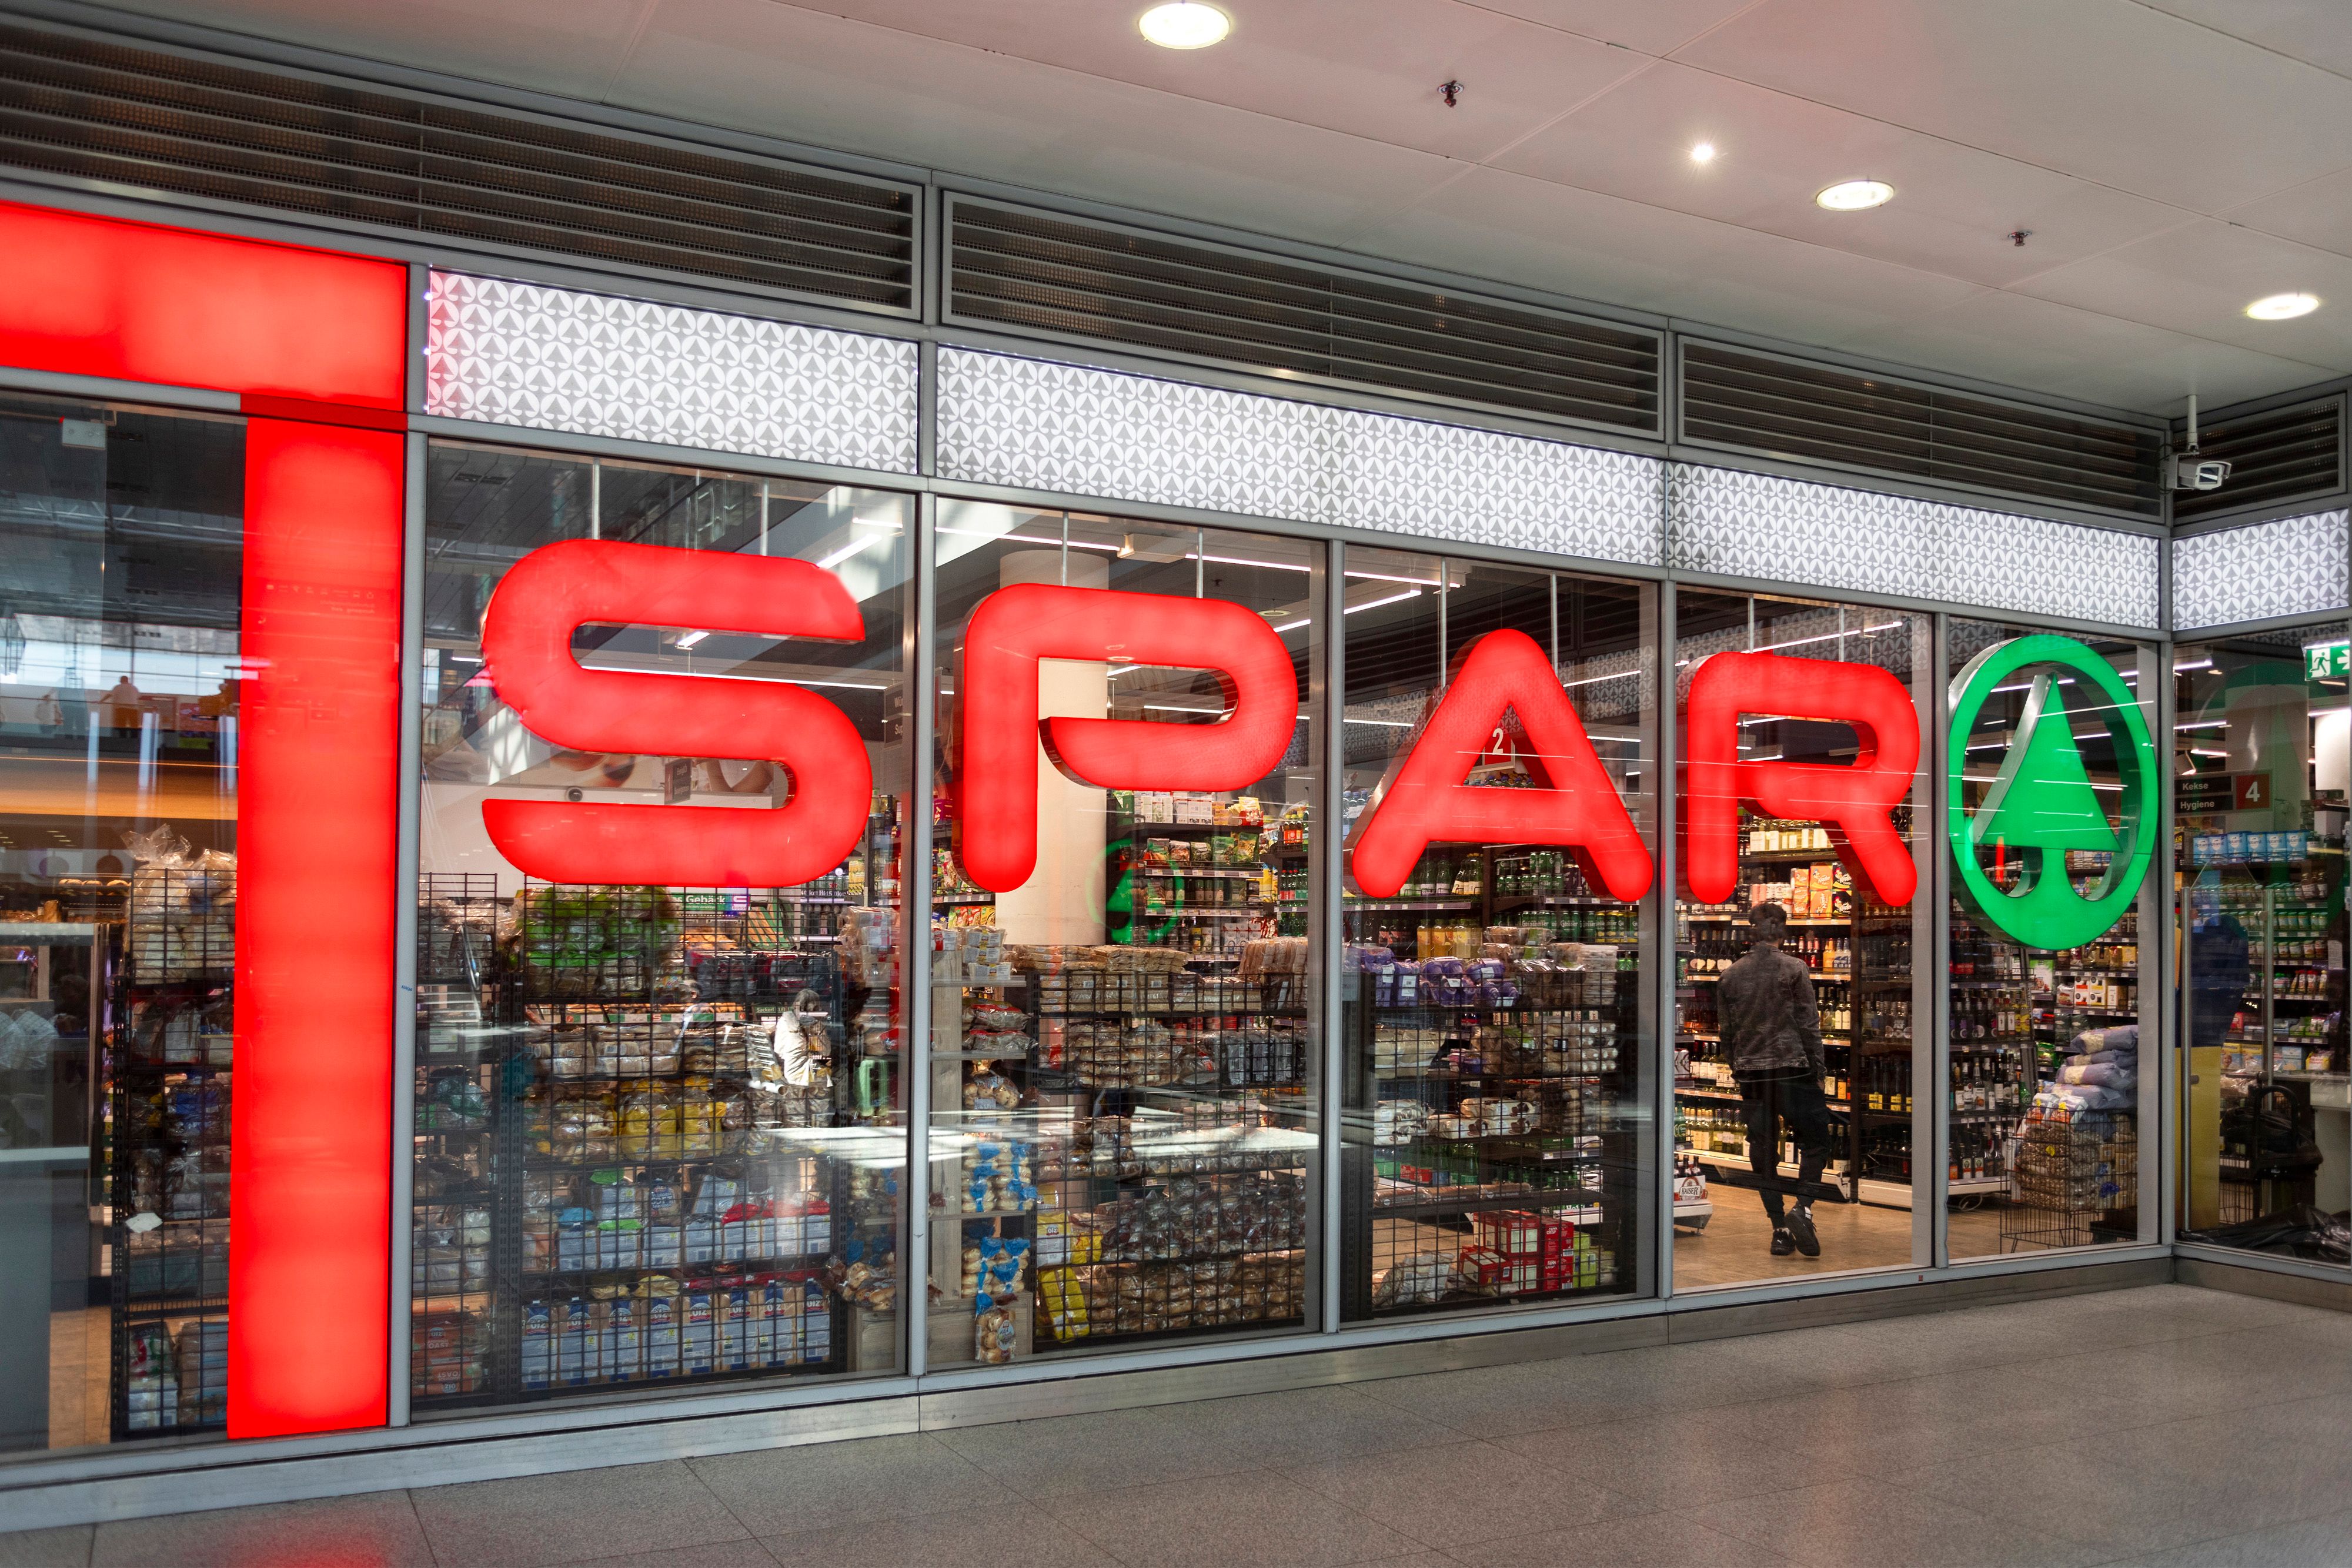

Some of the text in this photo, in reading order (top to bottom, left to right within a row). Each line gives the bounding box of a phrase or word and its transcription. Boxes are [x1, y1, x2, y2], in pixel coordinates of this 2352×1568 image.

[482, 539, 1920, 907] SPAR
[1492, 727, 1504, 754] 2
[2183, 783, 2209, 791] Kekse
[2245, 781, 2260, 803] 4
[2180, 801, 2215, 811] Hygiene
[686, 895, 726, 905] Gebäck
